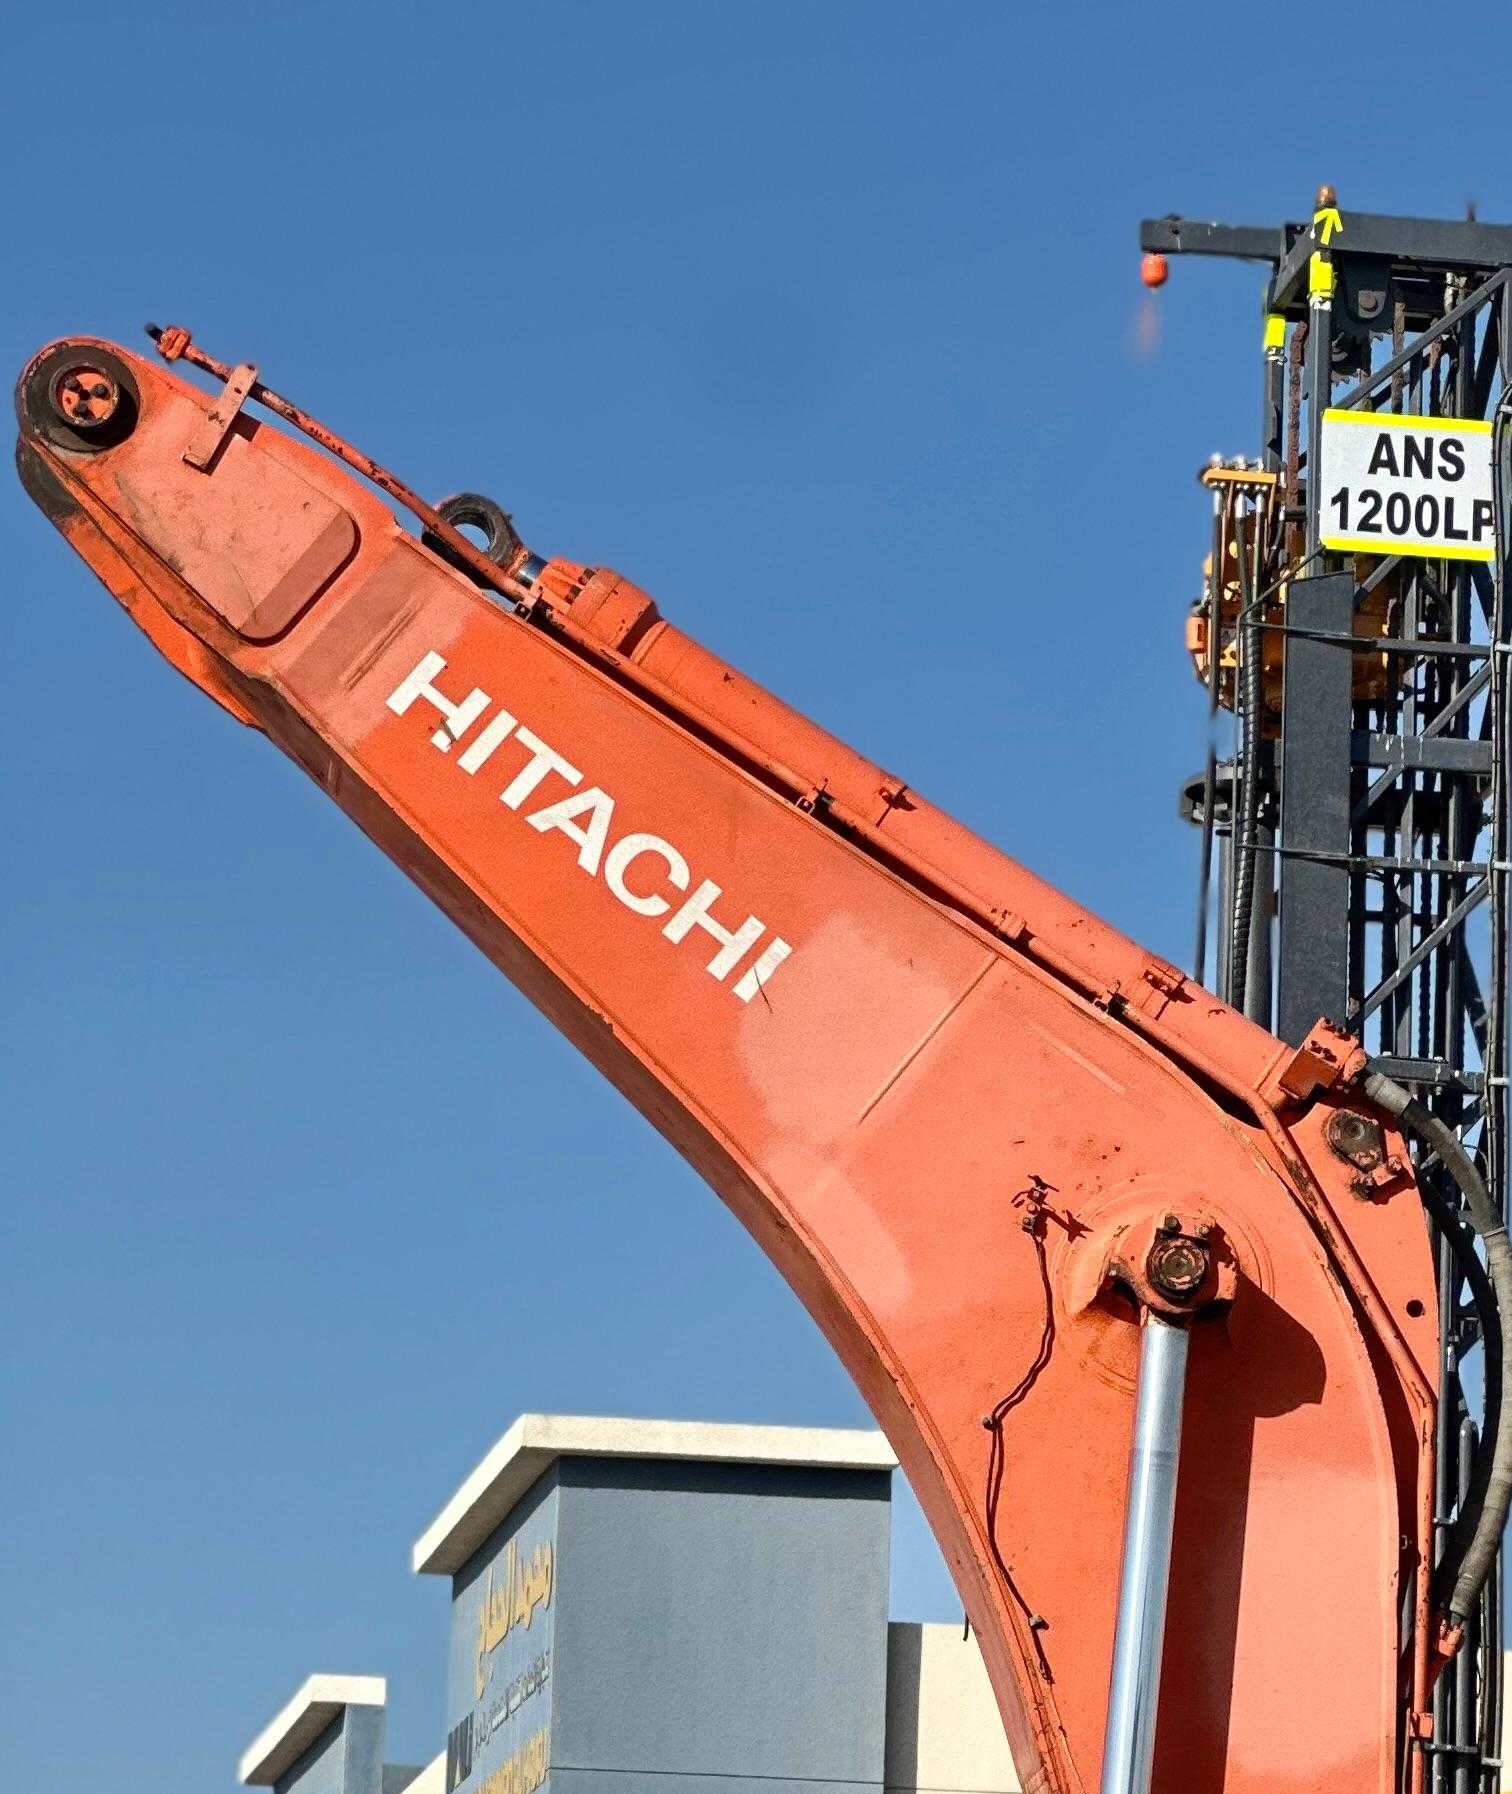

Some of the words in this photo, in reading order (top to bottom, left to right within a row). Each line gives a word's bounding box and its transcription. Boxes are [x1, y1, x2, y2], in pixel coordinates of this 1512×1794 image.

[1367, 432, 1466, 482] ANS
[1330, 486, 1495, 542] 1200LP
[385, 649, 793, 1004] HITACHI
